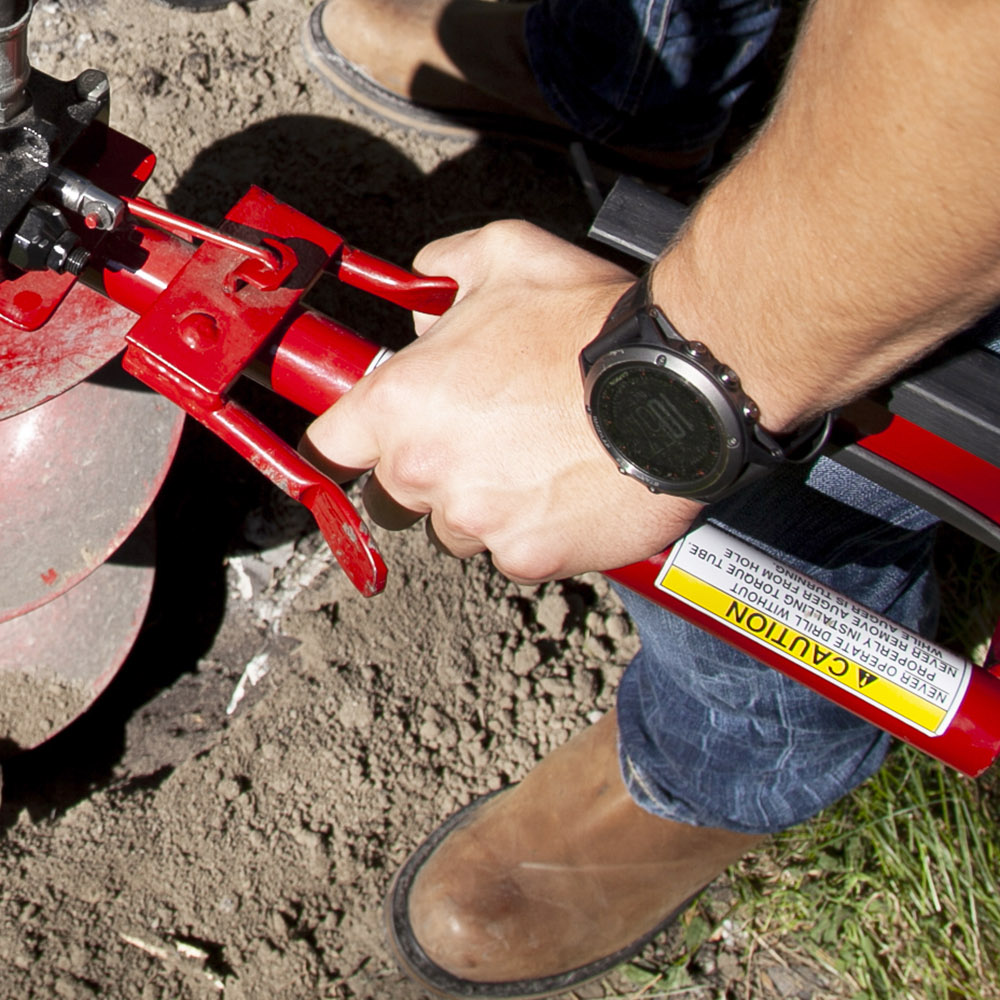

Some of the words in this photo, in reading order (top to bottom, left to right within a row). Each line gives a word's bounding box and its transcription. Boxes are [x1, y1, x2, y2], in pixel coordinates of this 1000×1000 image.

[688, 541, 722, 569] TUBE.
[723, 548, 760, 573] HOLE
[726, 563, 780, 600] TORQUE
[761, 568, 800, 594] FROM
[772, 562, 832, 600] TURNING.
[729, 583, 790, 621] WITHOUT
[802, 590, 849, 619] AUGER
[835, 595, 849, 606] IS
[783, 594, 861, 641] INSTALLING
[795, 614, 832, 642] DRILL
[851, 605, 898, 633] AUGER
[851, 615, 908, 652] REMOVE
[726, 601, 849, 677] CAUTION
[901, 631, 943, 659] WHILE
[833, 636, 898, 677] OPERATE
[863, 638, 936, 682] PROPERLY
[911, 645, 958, 678] NEVER
[900, 671, 949, 703] NEVER
